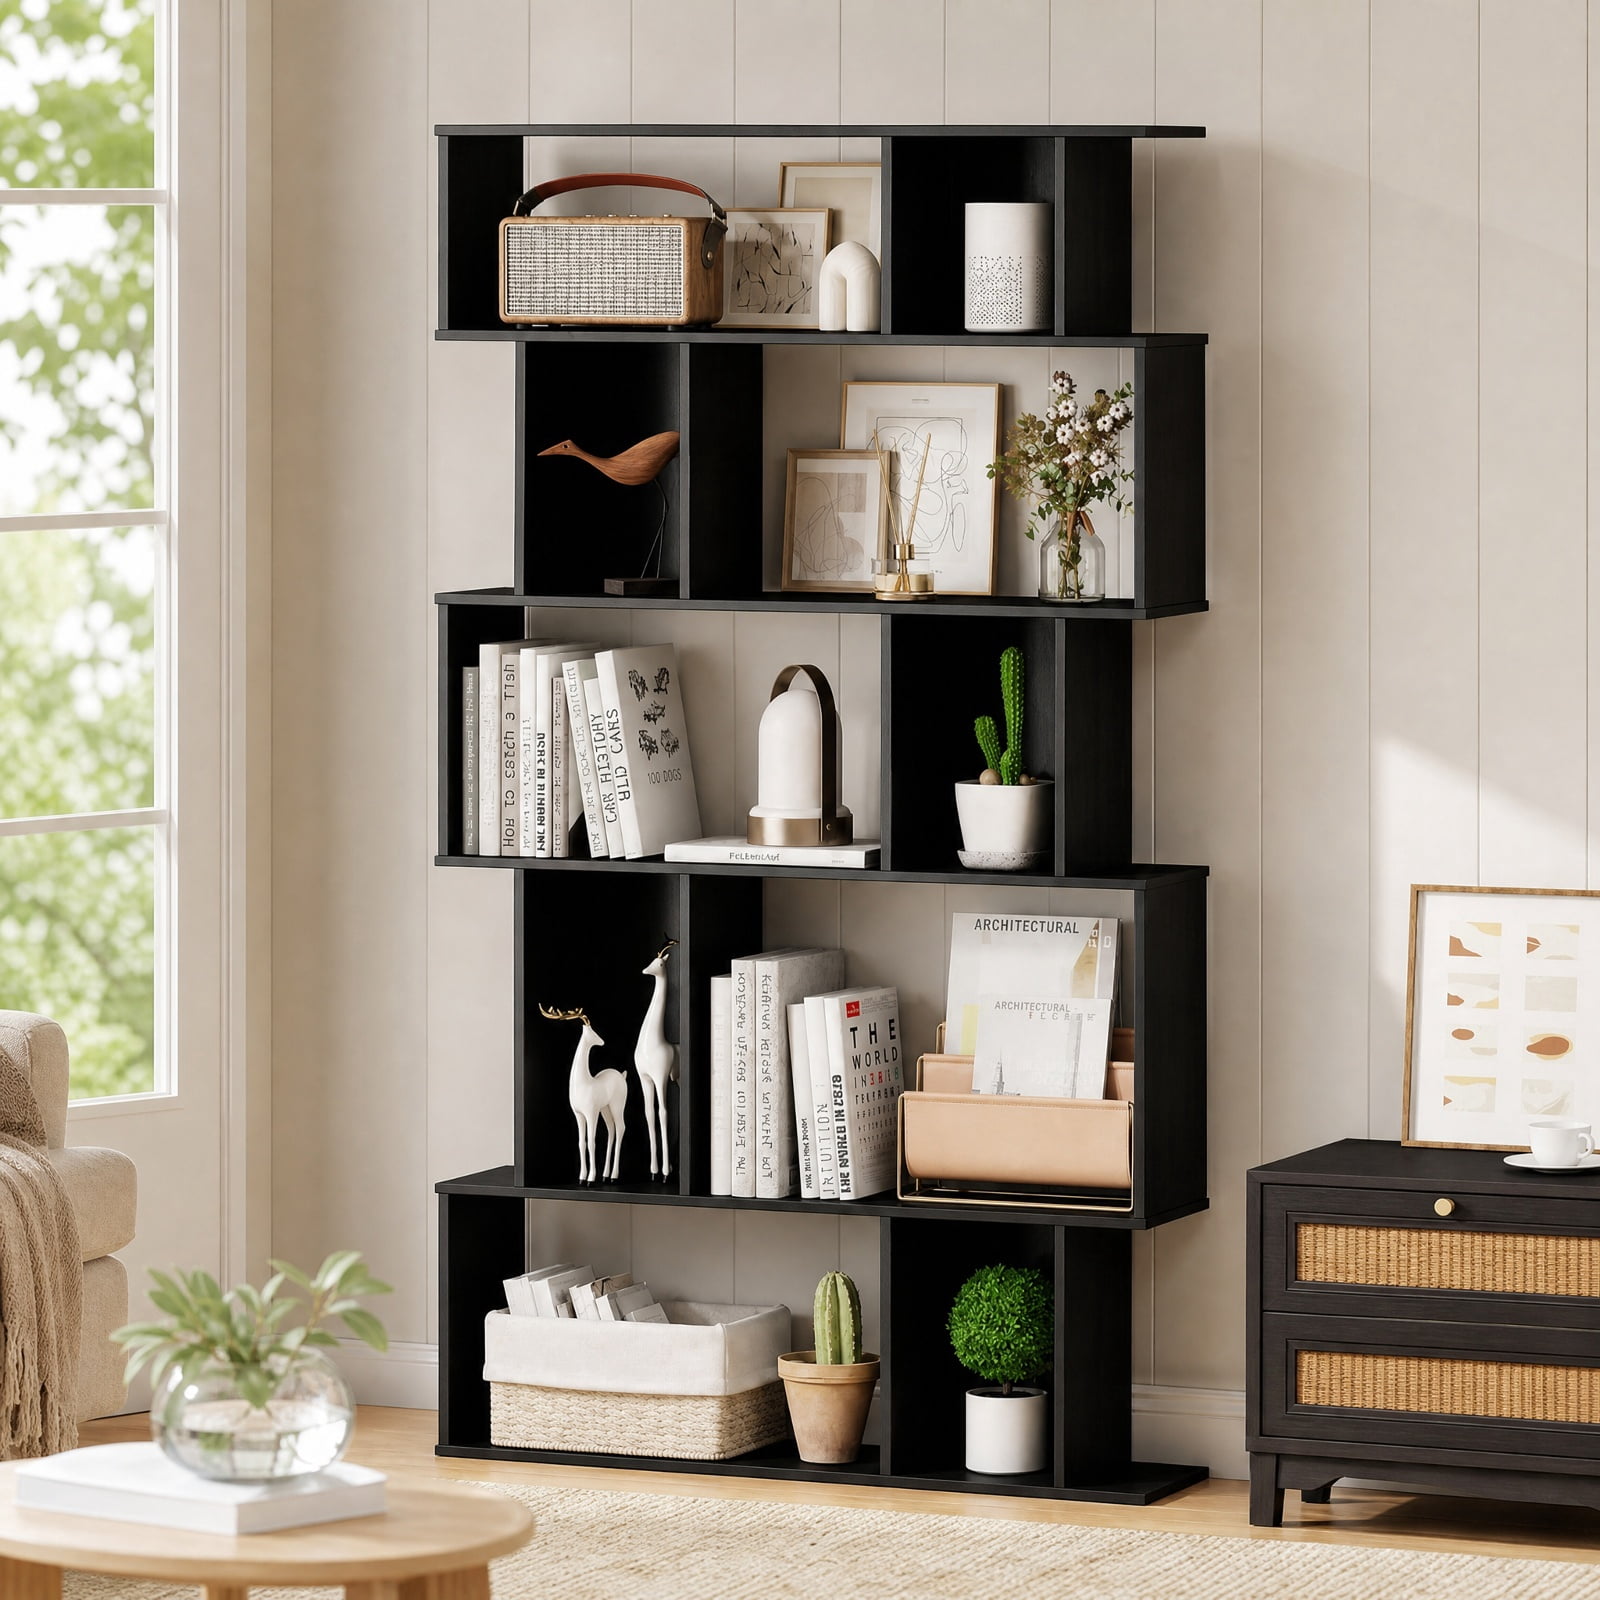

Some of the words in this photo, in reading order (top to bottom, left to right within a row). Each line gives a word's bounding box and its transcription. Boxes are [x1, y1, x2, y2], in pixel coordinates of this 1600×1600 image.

[647, 770, 661, 785] 100
[664, 767, 682, 783] DOGS
[974, 918, 1080, 934] ARCHITECTURAL
[994, 1000, 1071, 1013] ARCHITECTURAL
[849, 1018, 897, 1049] THE
[851, 1046, 899, 1070] WORLD
